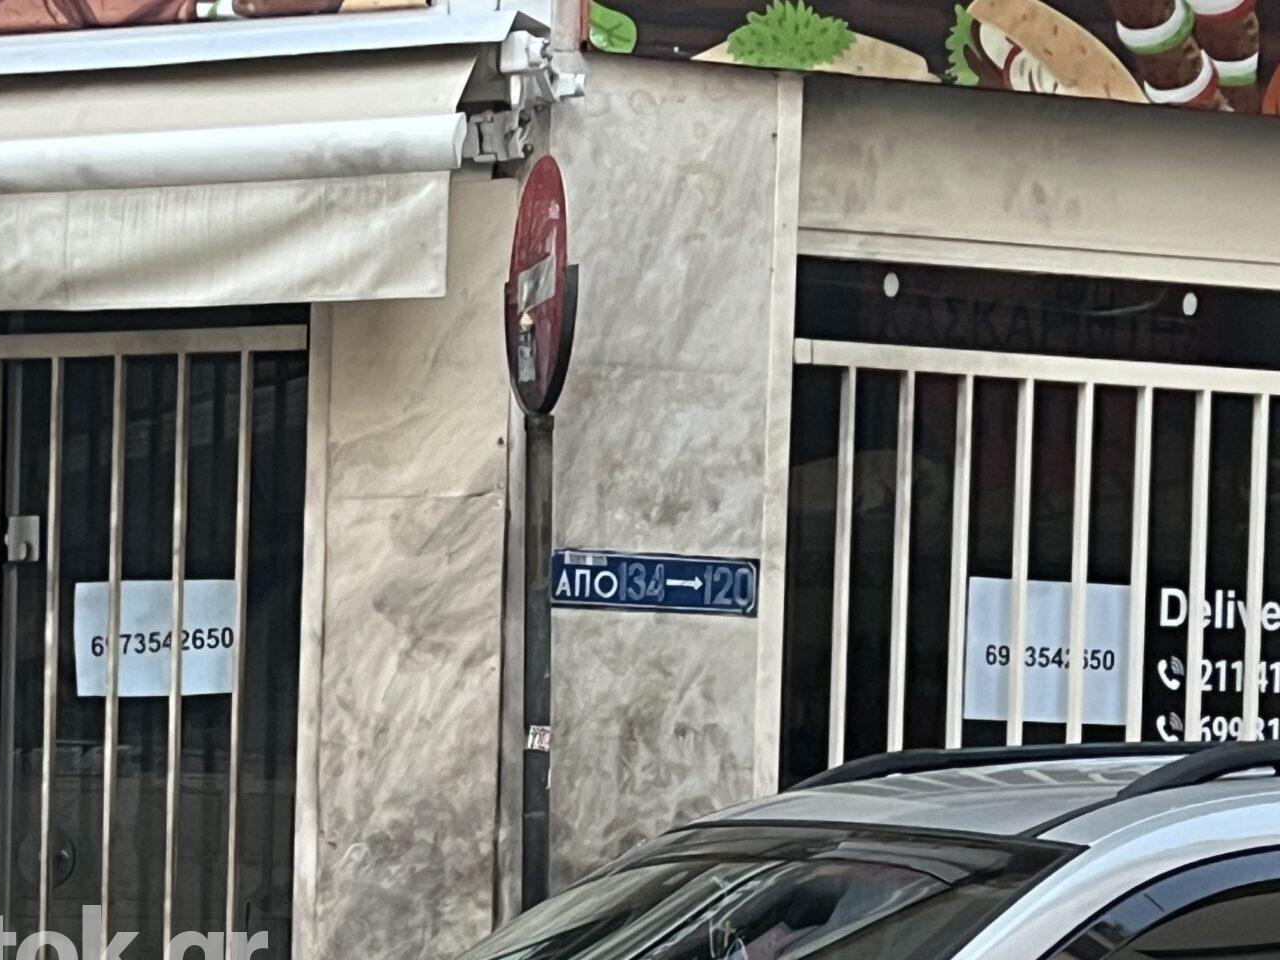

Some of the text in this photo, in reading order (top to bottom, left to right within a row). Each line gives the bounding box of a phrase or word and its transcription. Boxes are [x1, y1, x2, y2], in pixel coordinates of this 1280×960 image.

[555, 562, 754, 607] ΑΠΟ 134 120
[91, 627, 234, 657] 673542650
[985, 644, 1115, 681] 6935450
